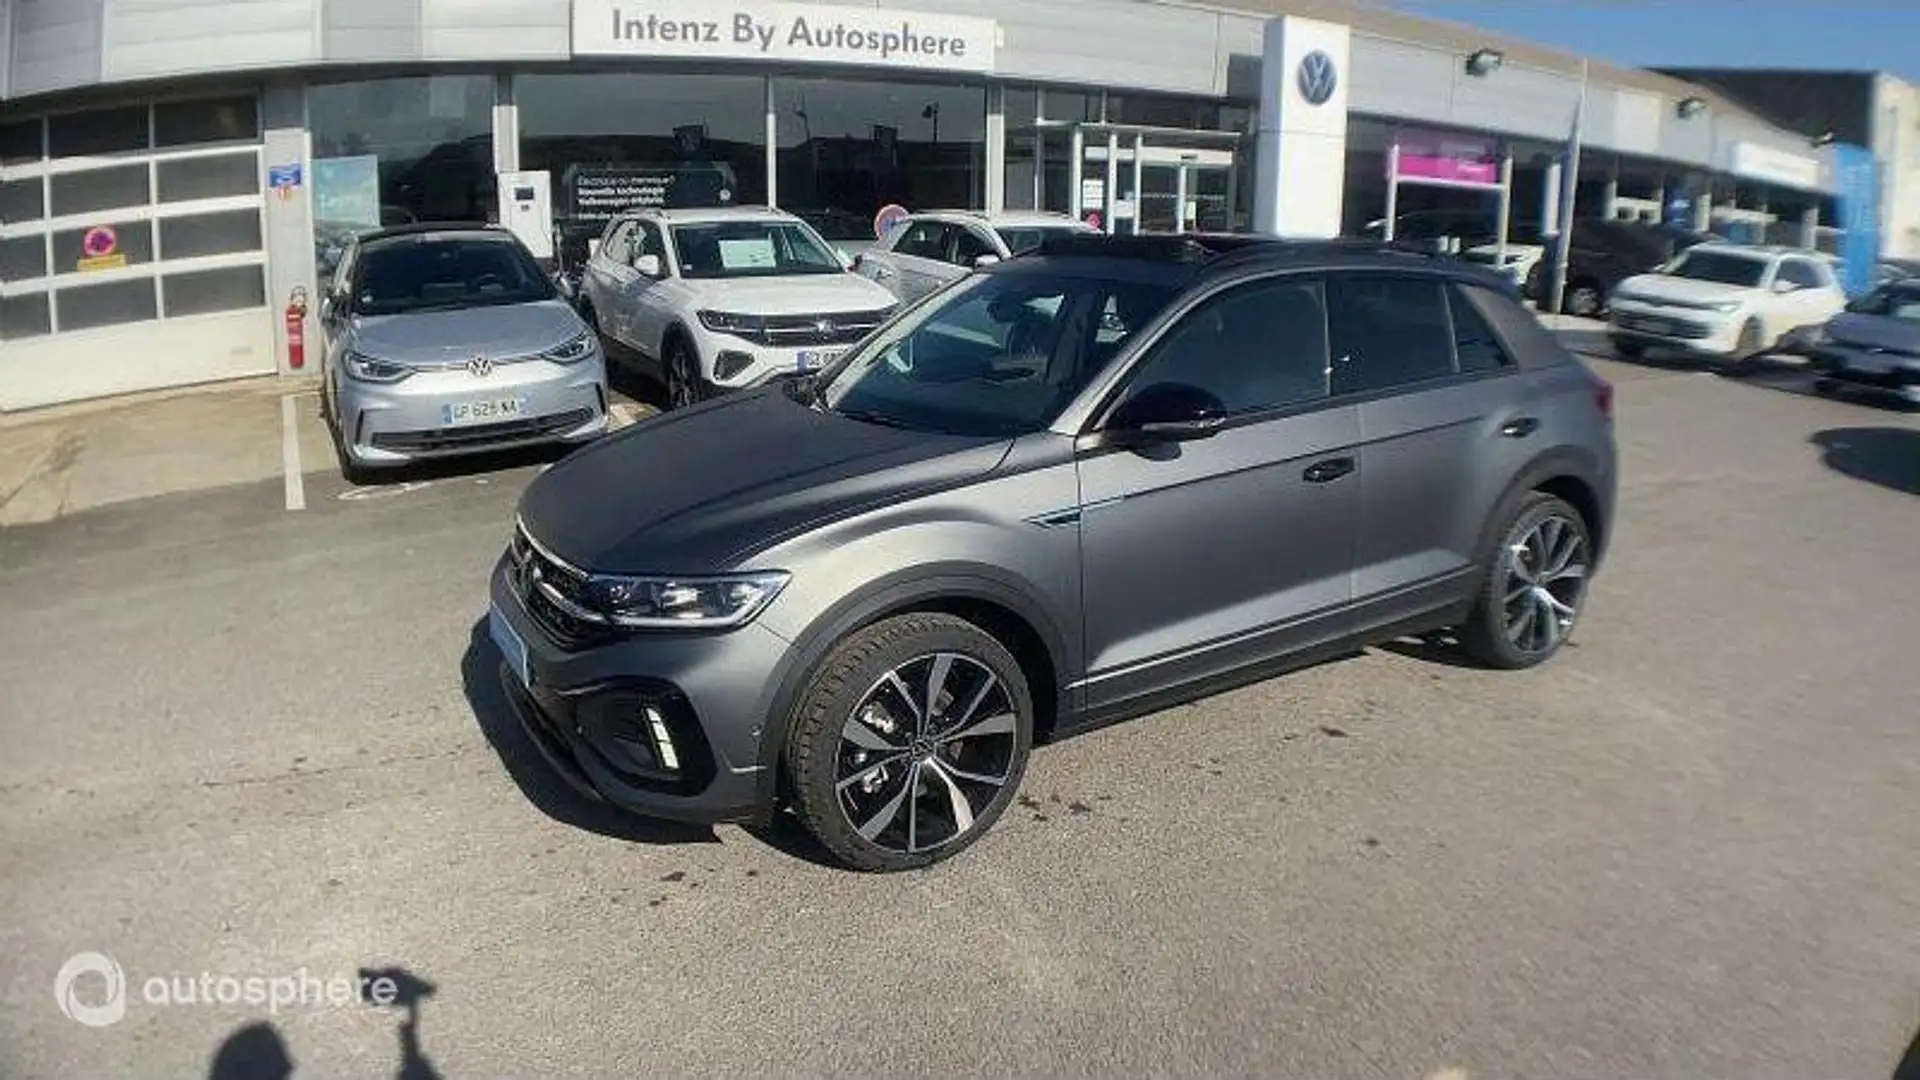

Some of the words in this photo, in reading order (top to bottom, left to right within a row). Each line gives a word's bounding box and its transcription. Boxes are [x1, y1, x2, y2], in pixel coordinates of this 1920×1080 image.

[612, 8, 720, 43] Intenz
[732, 13, 776, 52] By
[786, 16, 966, 58] Autosphere
